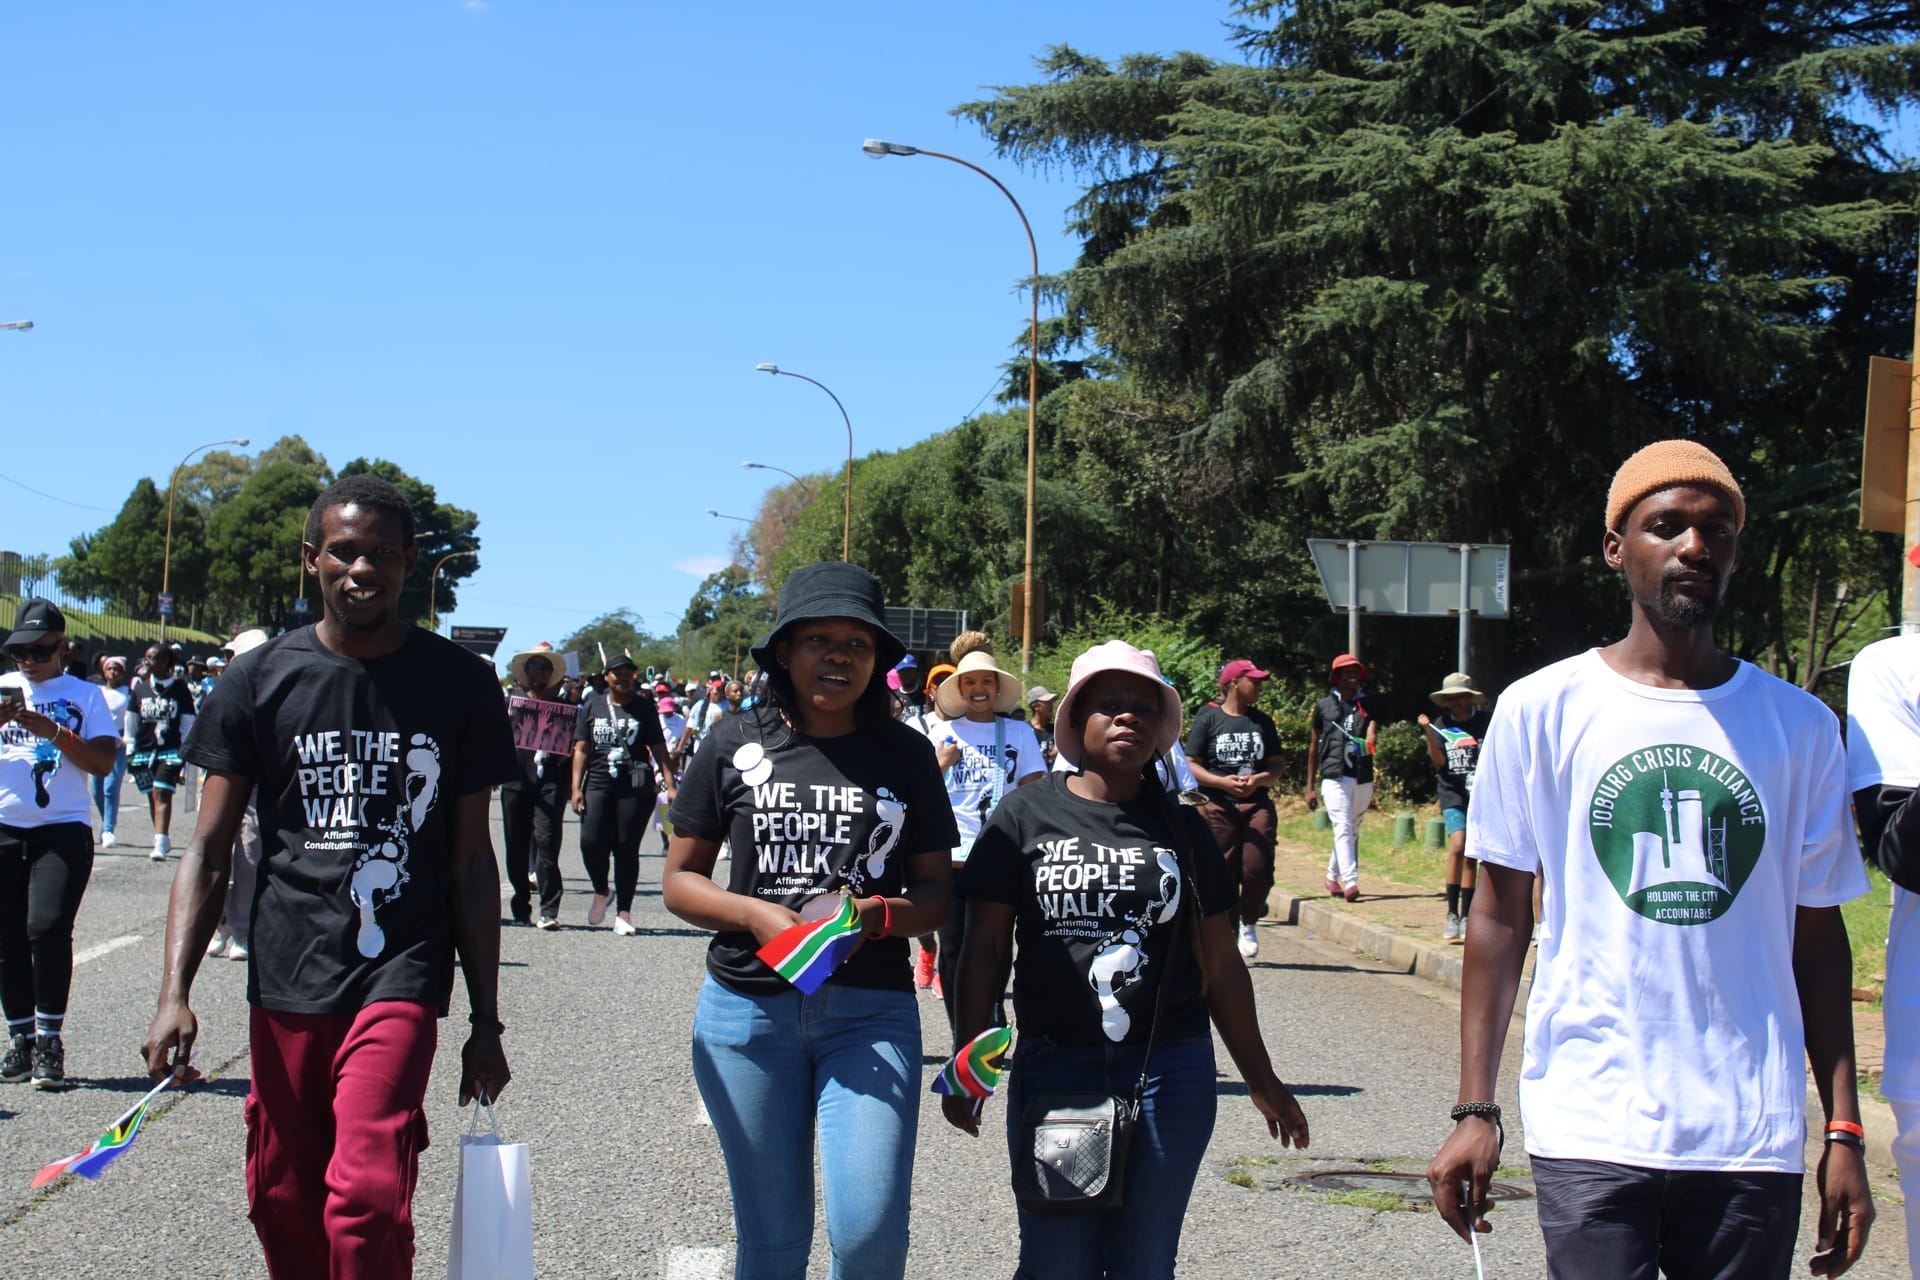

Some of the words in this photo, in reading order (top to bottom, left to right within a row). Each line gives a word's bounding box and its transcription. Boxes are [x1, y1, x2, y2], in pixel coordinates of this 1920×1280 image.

[0, 729, 40, 744] WAL
[294, 730, 349, 764] WE,
[351, 729, 400, 763] THE
[1216, 742, 1249, 753] PEOPLE
[1232, 732, 1250, 743] THE
[1216, 751, 1243, 762] WALK
[298, 762, 388, 796] PEOPLE
[953, 769, 988, 785] WALK
[1592, 763, 1634, 829] JOBURG
[1631, 747, 1693, 774] CRISIS
[1697, 753, 1763, 827] ALLIANCE
[302, 796, 369, 828] WALK
[752, 782, 801, 812] WE,
[809, 784, 864, 814] THE
[752, 811, 852, 845] PEOPLE
[755, 844, 833, 876] WALK
[1036, 836, 1085, 865] WE,
[1091, 842, 1147, 865] THE
[1035, 863, 1136, 894] PEOPLE
[1036, 892, 1118, 921] WALK
[1646, 890, 1684, 903] HOLDING
[1685, 890, 1701, 903] THE
[1701, 890, 1720, 903] CITY
[1655, 907, 1713, 920] ACCOUNTABLE
[1042, 927, 1114, 939] onstitutionalism
